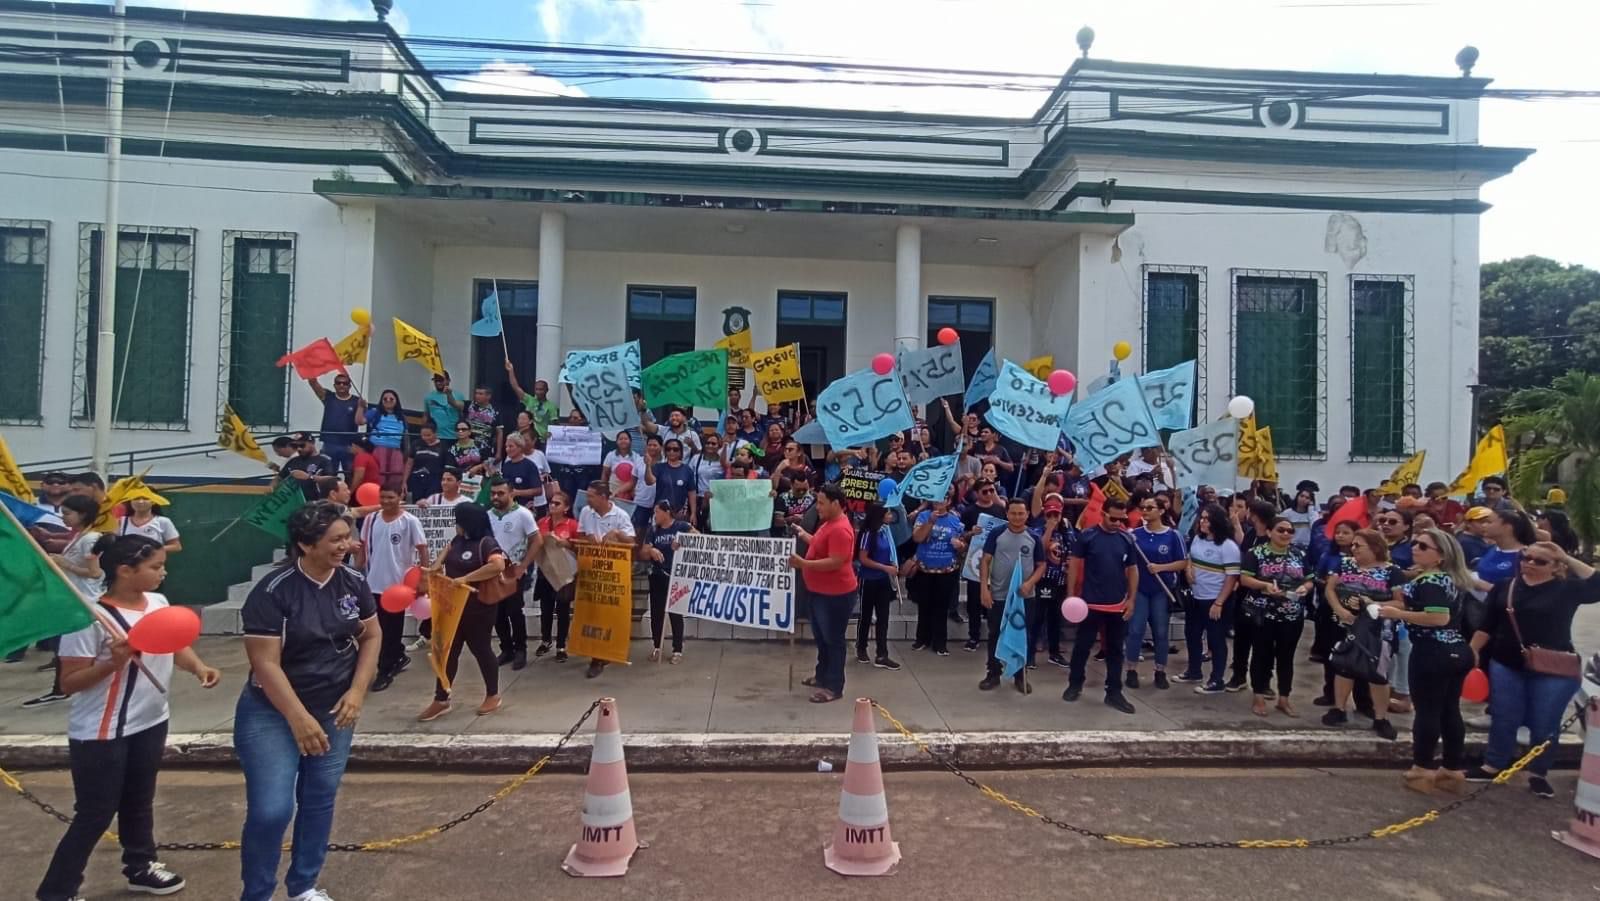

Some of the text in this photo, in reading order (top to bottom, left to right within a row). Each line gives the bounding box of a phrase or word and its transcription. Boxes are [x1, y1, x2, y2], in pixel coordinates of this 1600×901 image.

[762, 378, 802, 396] GRAVE
[720, 537, 772, 555] PROFISSIONAIS
[681, 550, 715, 566] MUNICIPAL
[717, 553, 727, 567] DE
[674, 563, 688, 578] EM
[756, 572, 775, 590] TEM
[688, 581, 771, 626] REAJUSTE
[582, 825, 623, 843] IMTT
[845, 826, 885, 844] IMTT
